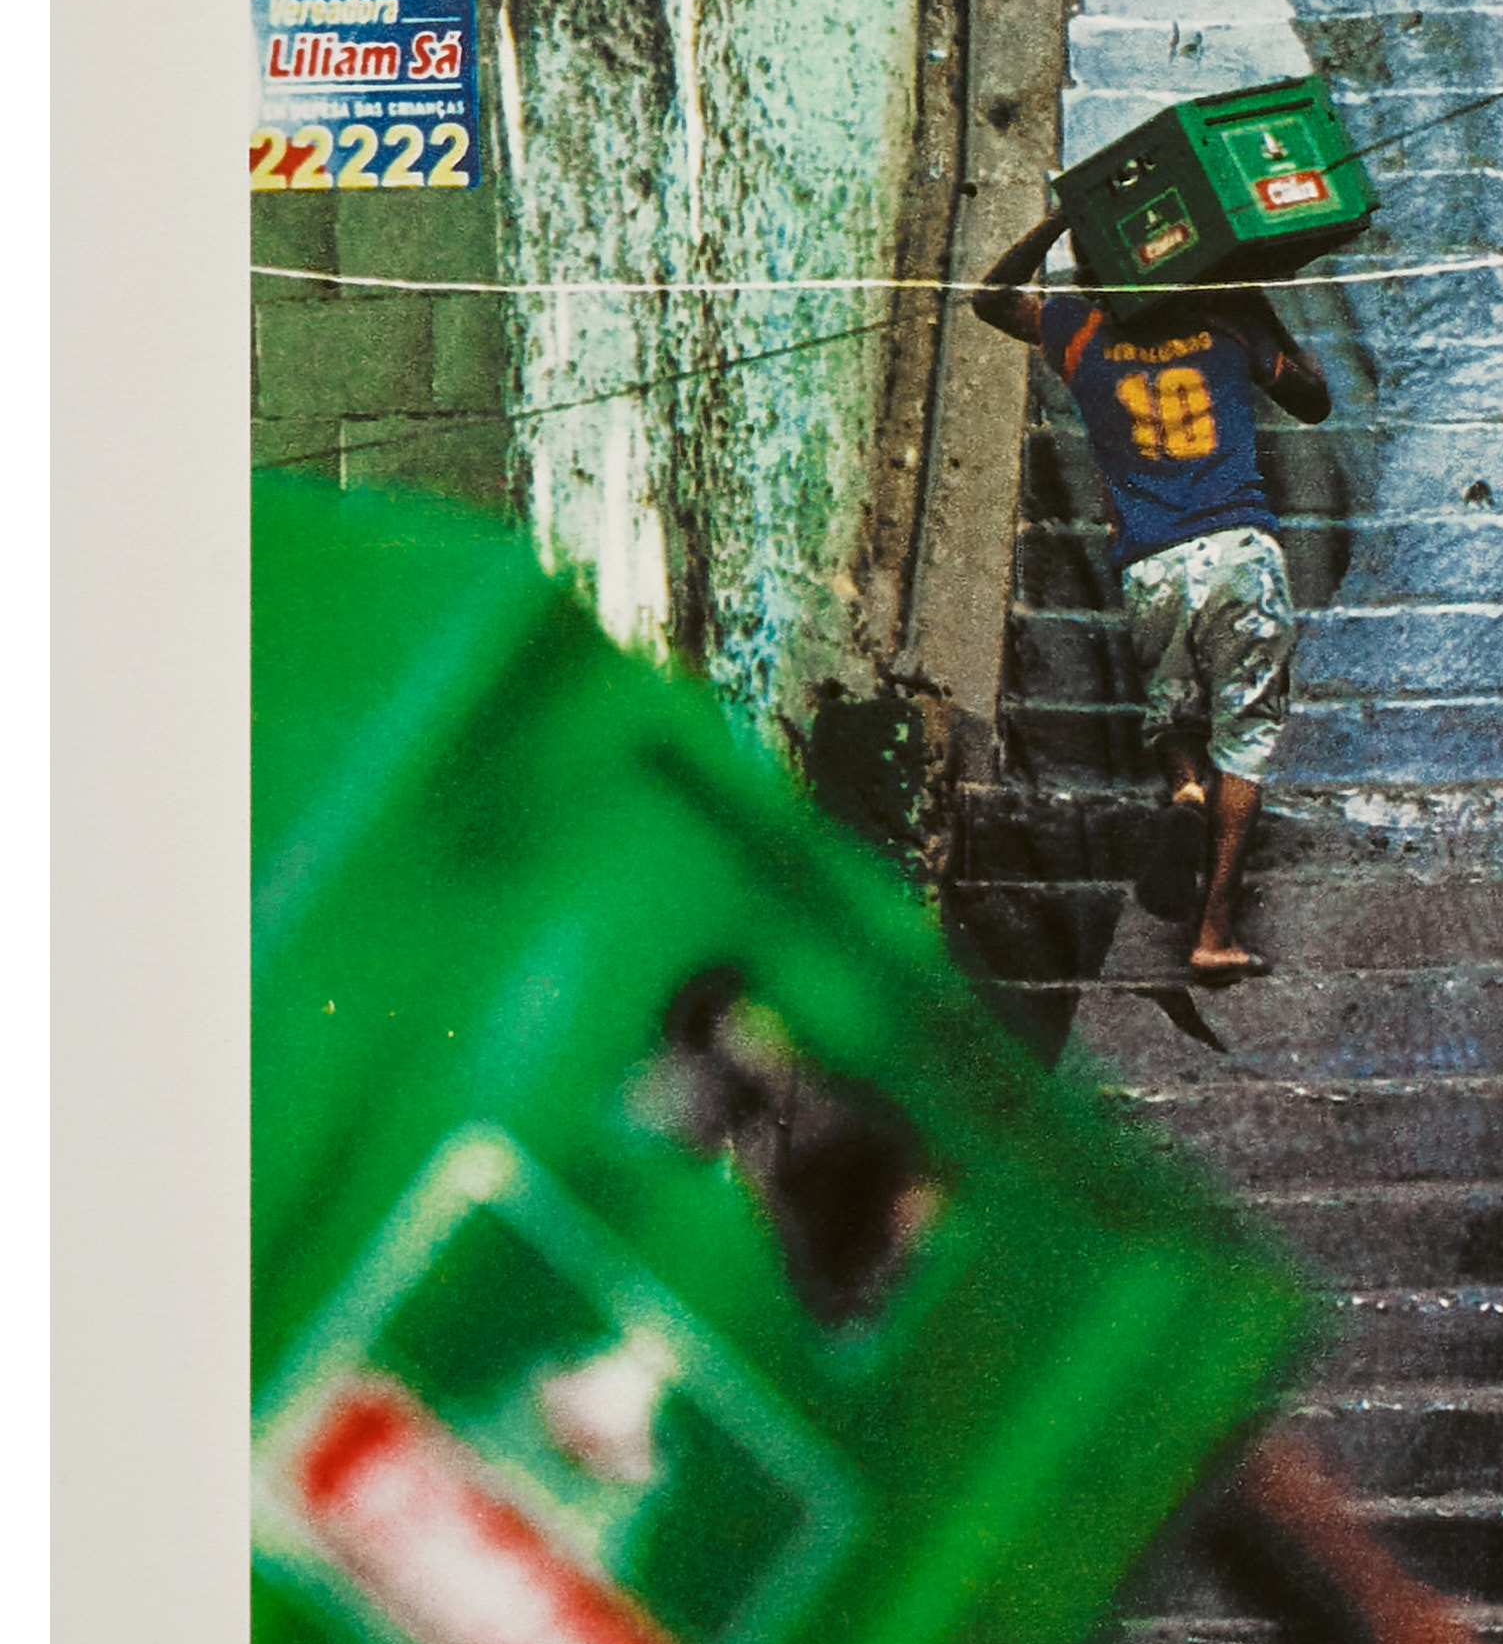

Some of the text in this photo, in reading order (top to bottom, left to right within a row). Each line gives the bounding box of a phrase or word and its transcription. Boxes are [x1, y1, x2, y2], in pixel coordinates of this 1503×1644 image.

[267, 32, 463, 79] Liliam Sá
[388, 100, 465, 119] CRIANÇAS
[250, 123, 470, 190] 22222
